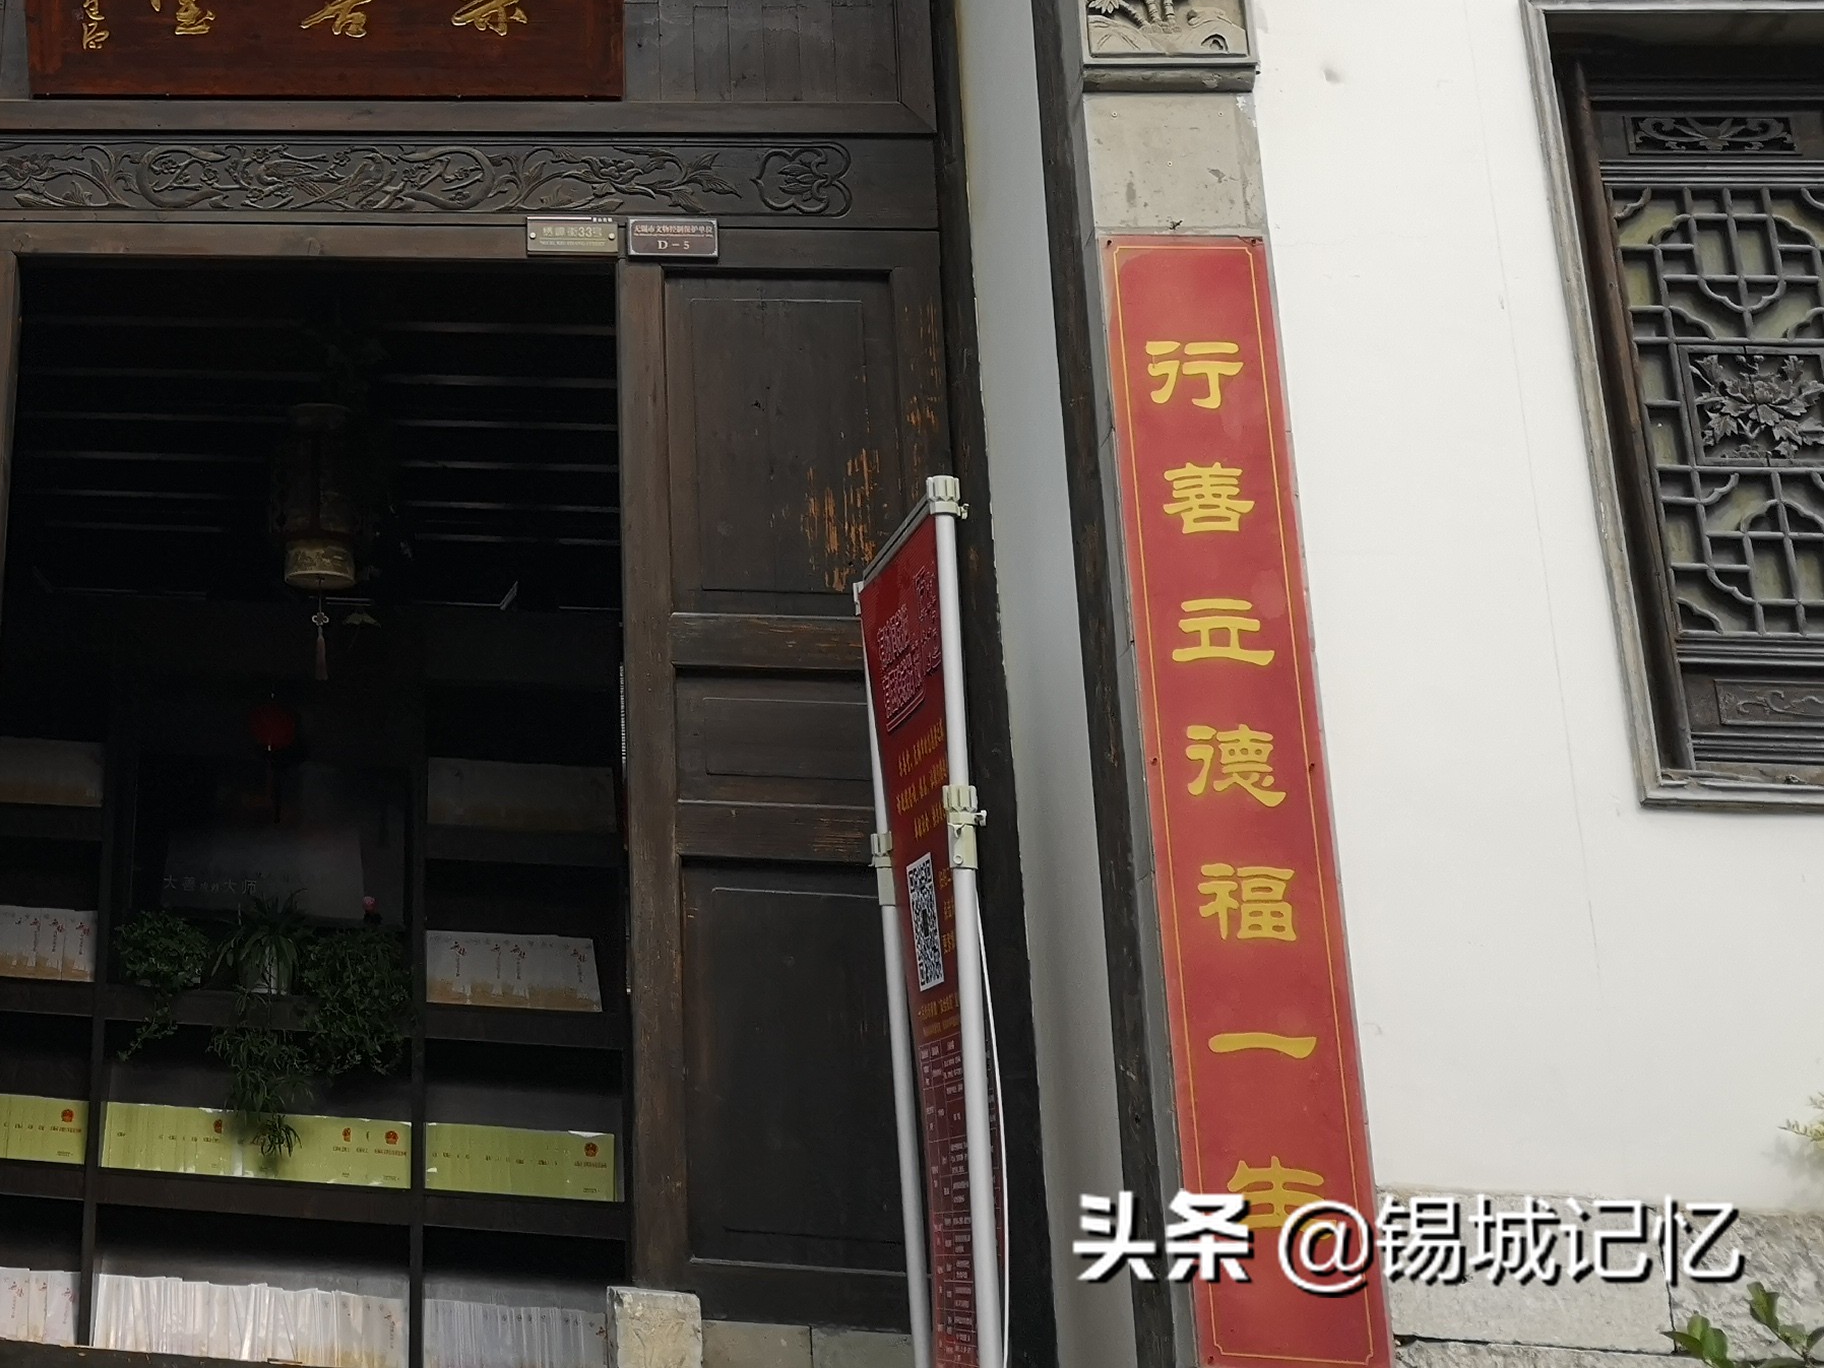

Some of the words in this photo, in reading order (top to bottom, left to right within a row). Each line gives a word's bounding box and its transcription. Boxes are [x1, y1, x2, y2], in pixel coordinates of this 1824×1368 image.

[1144, 340, 1337, 1241] 行善立德福一生
